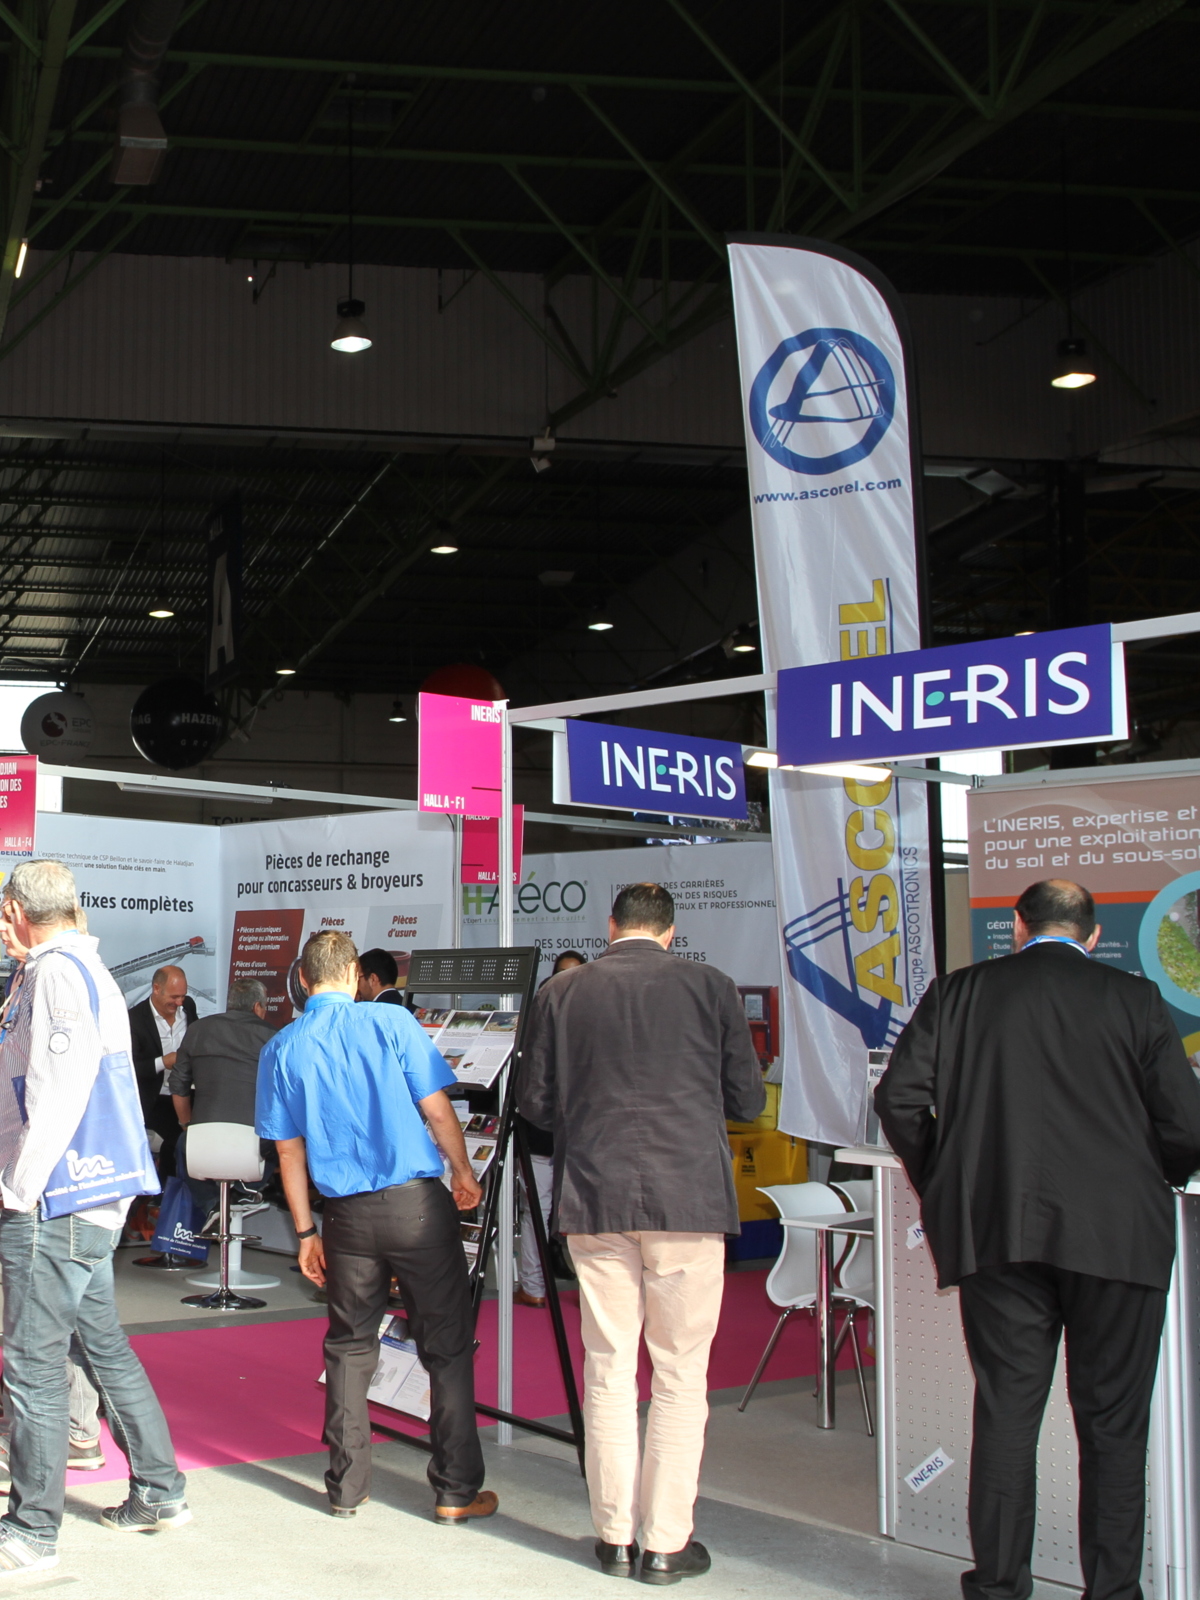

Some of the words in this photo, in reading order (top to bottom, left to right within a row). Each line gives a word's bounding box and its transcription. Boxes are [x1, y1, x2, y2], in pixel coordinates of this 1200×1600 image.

[753, 477, 902, 505] www.ascorel.com
[831, 651, 1090, 739] INERIS
[181, 712, 223, 727] HAZEM
[471, 704, 501, 724] INERIS
[601, 740, 737, 801] INERIS
[9, 778, 22, 792] DES
[839, 578, 905, 1007] ASCOEL
[423, 793, 443, 808] HALL
[443, 795, 450, 809] A
[455, 796, 465, 810] F1
[983, 814, 1065, 834] L'INERIS,
[1072, 809, 1169, 830] expertise
[1177, 805, 1198, 821] et
[3, 836, 17, 848] HALL
[17, 837, 22, 848] A
[25, 836, 33, 848] F4
[984, 838, 1028, 855] pour
[1035, 836, 1072, 849] une
[1079, 826, 1200, 848] exploitation
[37, 850, 65, 860] L'expertise
[66, 852, 91, 862] technique
[92, 854, 99, 862] de
[99, 854, 109, 862] CSP
[110, 855, 126, 863] Beillon
[133, 856, 138, 864] le
[138, 857, 165, 866] savoir-faire
[166, 858, 172, 866] de
[173, 859, 194, 869] Haladjian
[265, 853, 303, 871] Pièces
[306, 852, 322, 868] de
[326, 849, 390, 869] rechange
[985, 856, 1009, 870] du
[1016, 854, 1044, 869] sol
[1051, 852, 1071, 867] et
[1078, 851, 1105, 866] du
[1112, 847, 1200, 864] sous-sol
[95, 862, 117, 870] solution
[118, 863, 133, 871] fiable
[134, 864, 144, 872] clés
[477, 872, 491, 881] HALL
[491, 873, 497, 881] A
[237, 880, 264, 898] pour
[267, 876, 343, 894] concasseurs
[347, 873, 357, 890] &
[361, 872, 424, 892] broyeurs
[663, 881, 678, 890] DES
[680, 878, 725, 889] CARRIÈRES
[685, 891, 701, 900] DES
[703, 890, 738, 899] RISQUES
[903, 846, 922, 955] ASCOTRONICS
[79, 891, 117, 910] fixes
[121, 895, 194, 914] complètes
[698, 902, 708, 910] ET
[710, 899, 777, 910] PROFESSIONNEL
[321, 916, 346, 927] Pièces
[392, 914, 418, 925] Pièces
[552, 914, 586, 922] sécurité
[255, 926, 282, 934] mécaniques
[387, 928, 418, 938] d'usure
[239, 935, 259, 943] d'origine
[264, 934, 290, 942] alternative
[535, 938, 553, 949] DES
[556, 937, 610, 949] SOLUTION
[992, 933, 1013, 941] Inspec
[237, 943, 245, 951] de
[245, 943, 260, 952] qualité
[260, 943, 281, 951] premium
[1091, 951, 1122, 959] mentaires
[235, 960, 251, 968] Pièces
[251, 960, 267, 968] d'usure
[242, 969, 257, 977] qualité
[257, 969, 278, 977] conforme
[910, 1456, 945, 1488] INERIS
